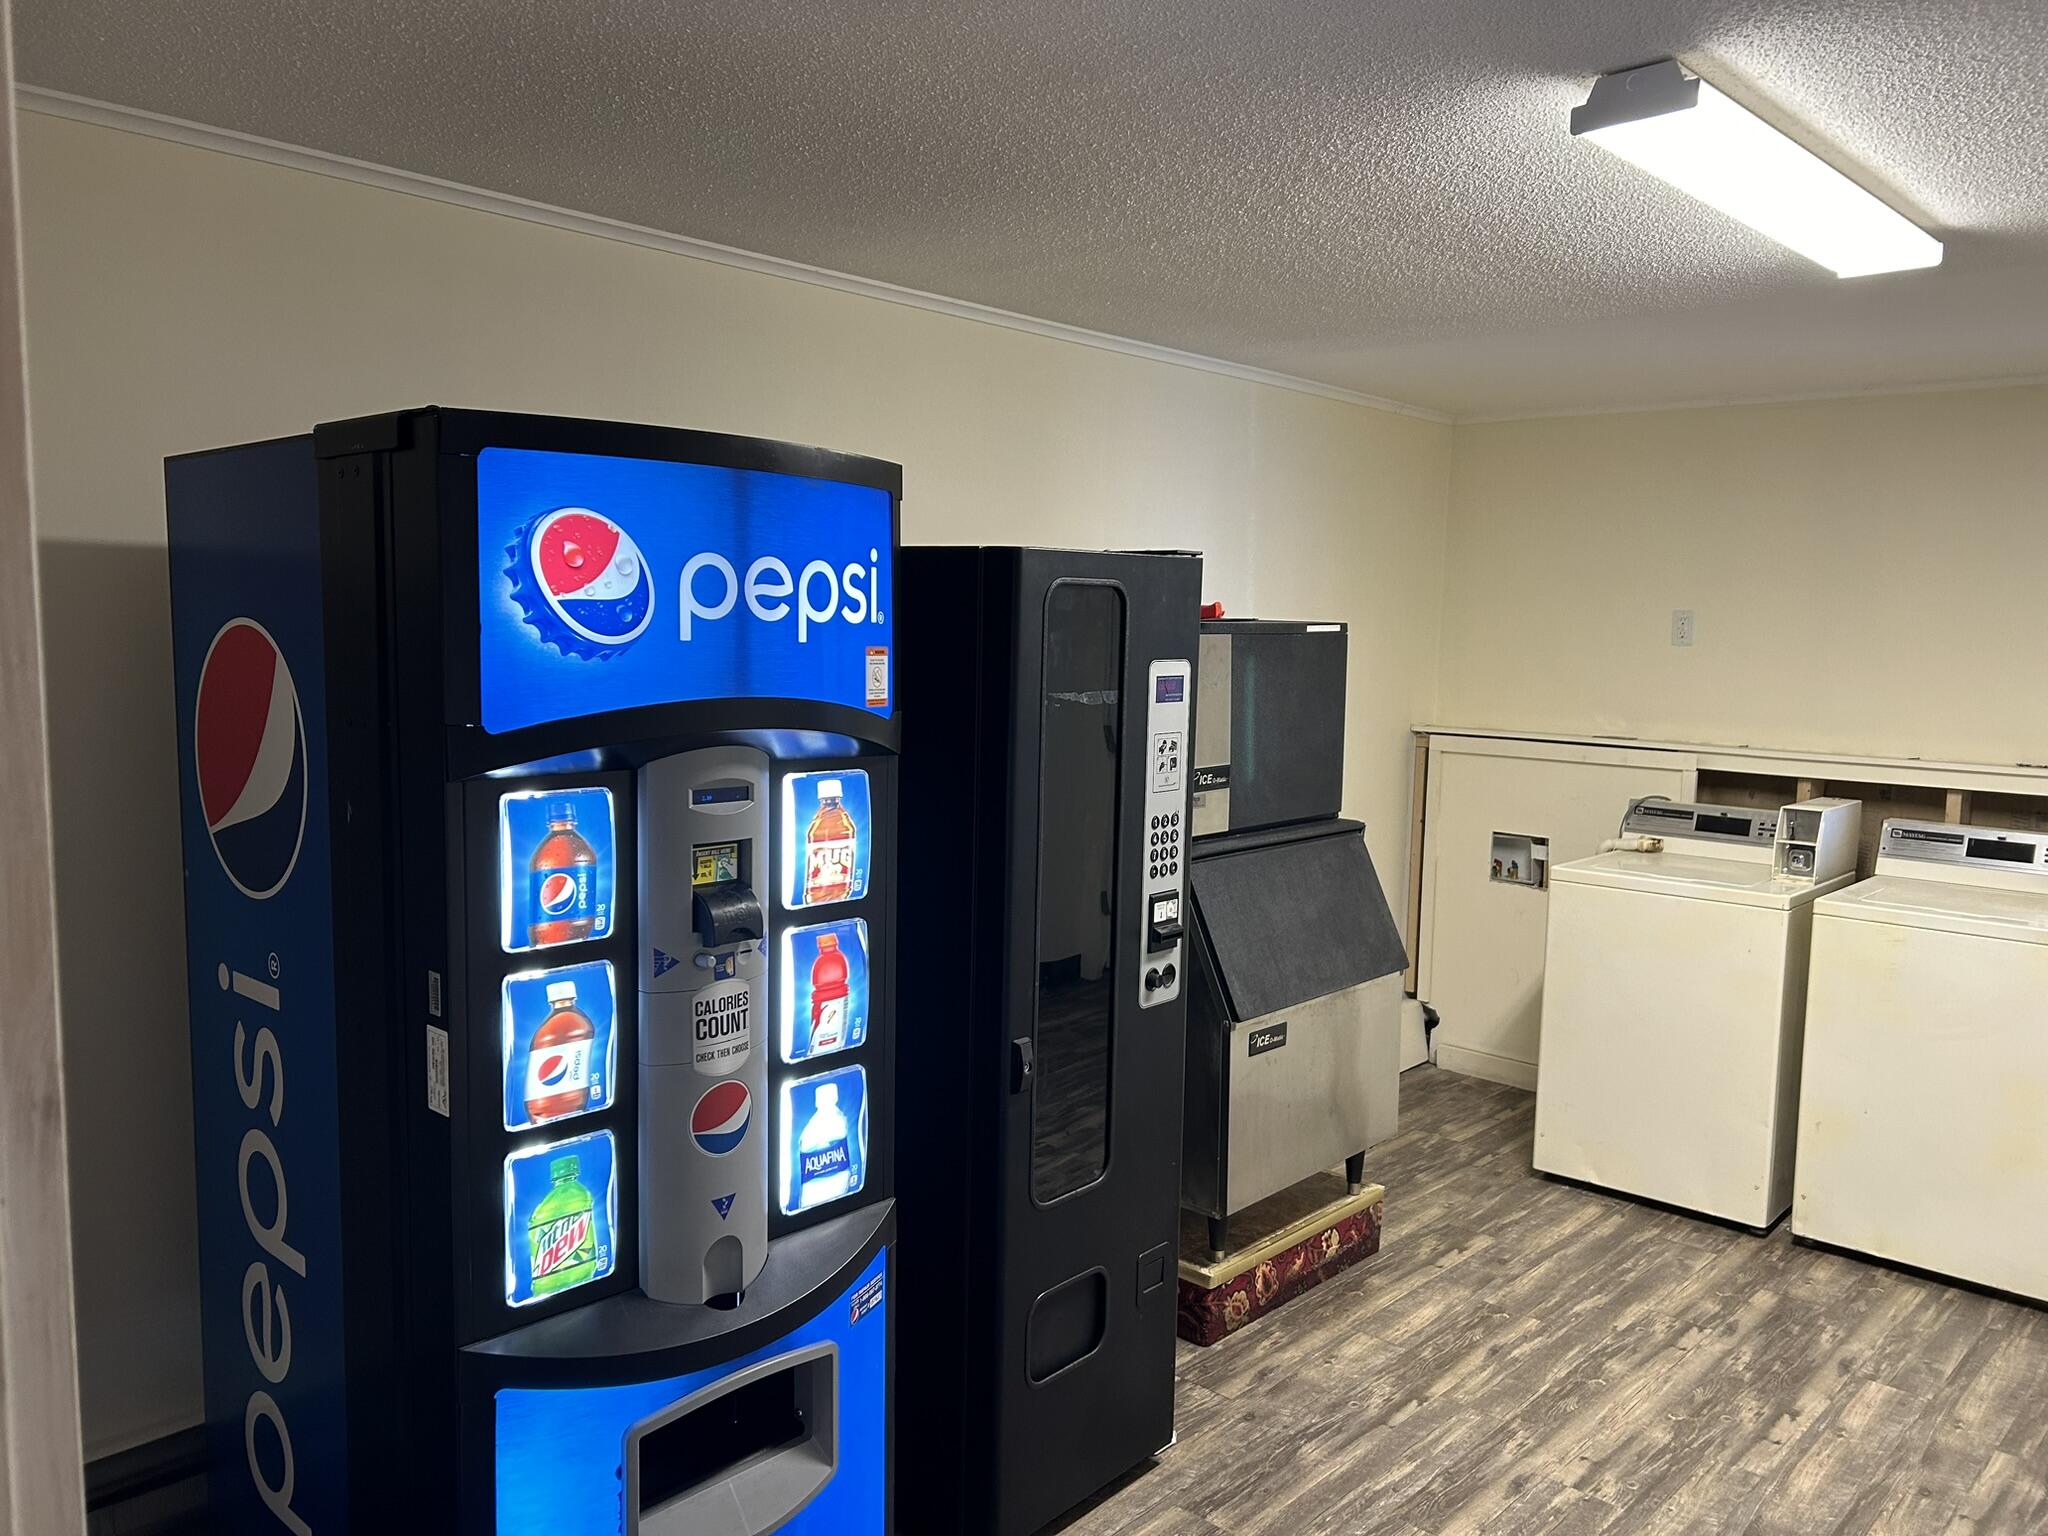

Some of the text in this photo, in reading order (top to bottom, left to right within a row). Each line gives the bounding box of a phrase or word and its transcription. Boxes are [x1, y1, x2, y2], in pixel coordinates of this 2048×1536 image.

[695, 991, 748, 1017] CALORIES
[696, 1008, 748, 1041] COUNT
[696, 1041, 749, 1063] CHECK THEN CHOOSE
[1256, 1034, 1271, 1047] ICE
[805, 1147, 847, 1175] AQUAFINA
